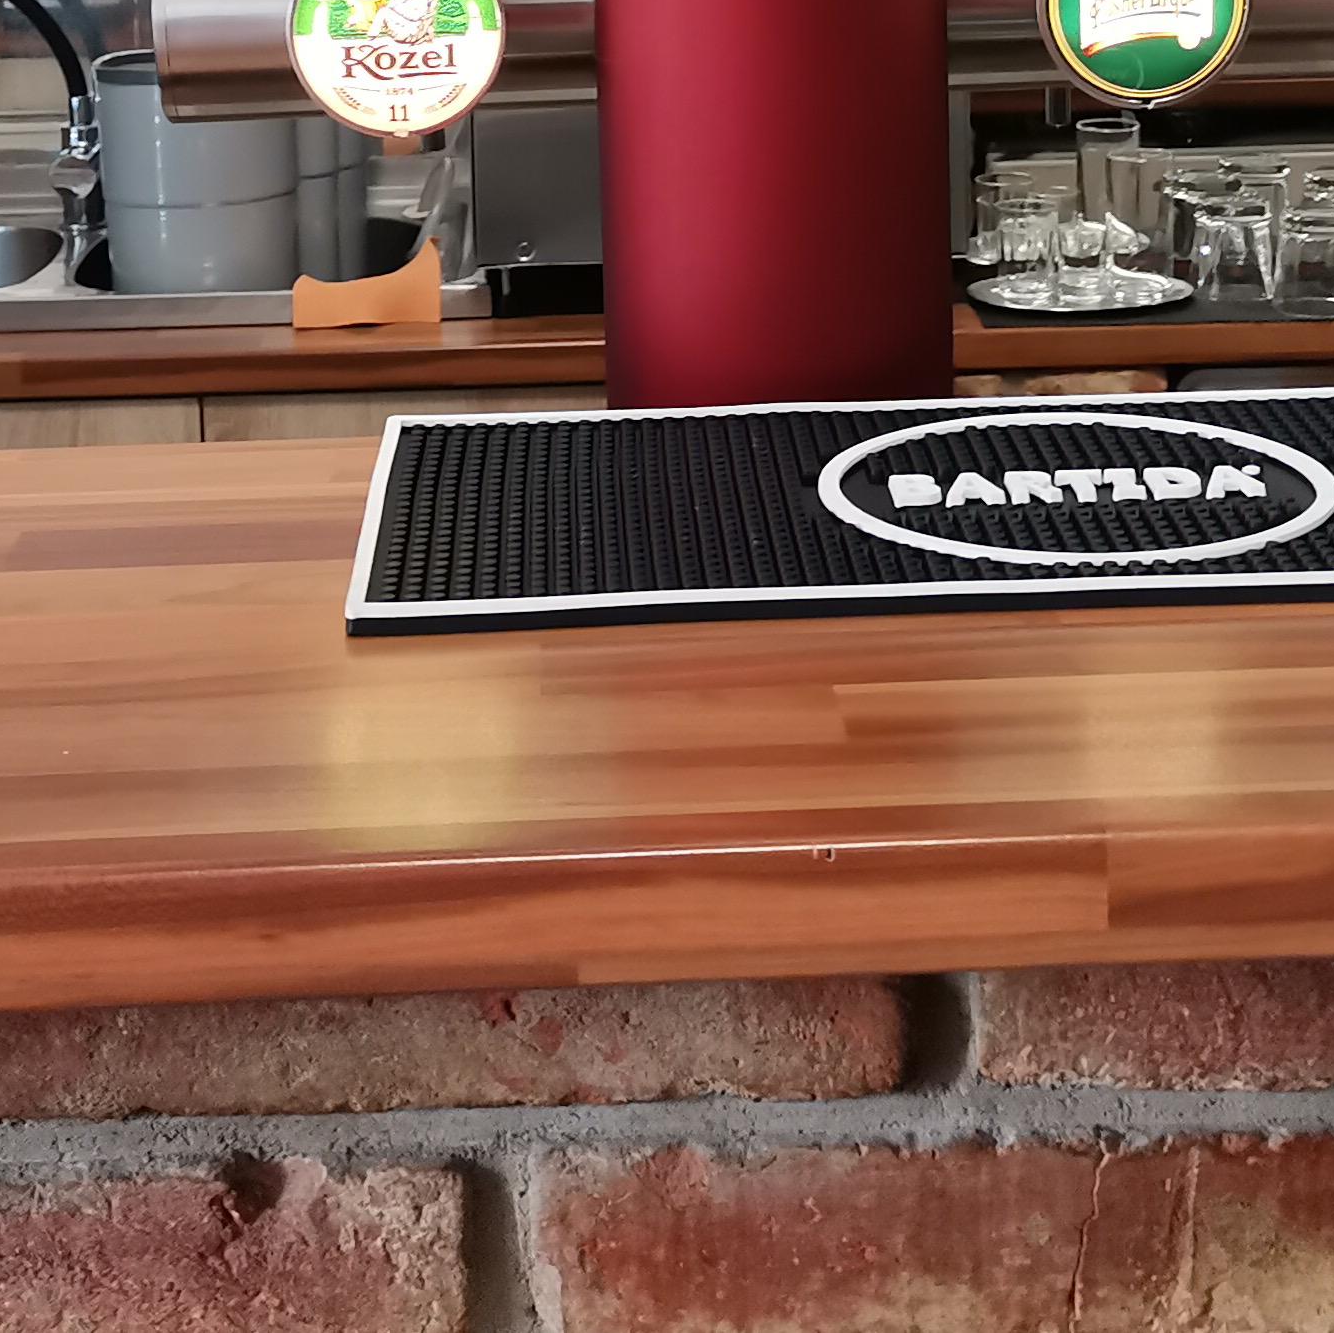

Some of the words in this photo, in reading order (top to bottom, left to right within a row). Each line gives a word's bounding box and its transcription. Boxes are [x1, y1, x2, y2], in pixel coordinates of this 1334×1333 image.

[340, 42, 458, 81] Kozel
[389, 105, 410, 122] 11
[888, 464, 1267, 508] BARTIDA
